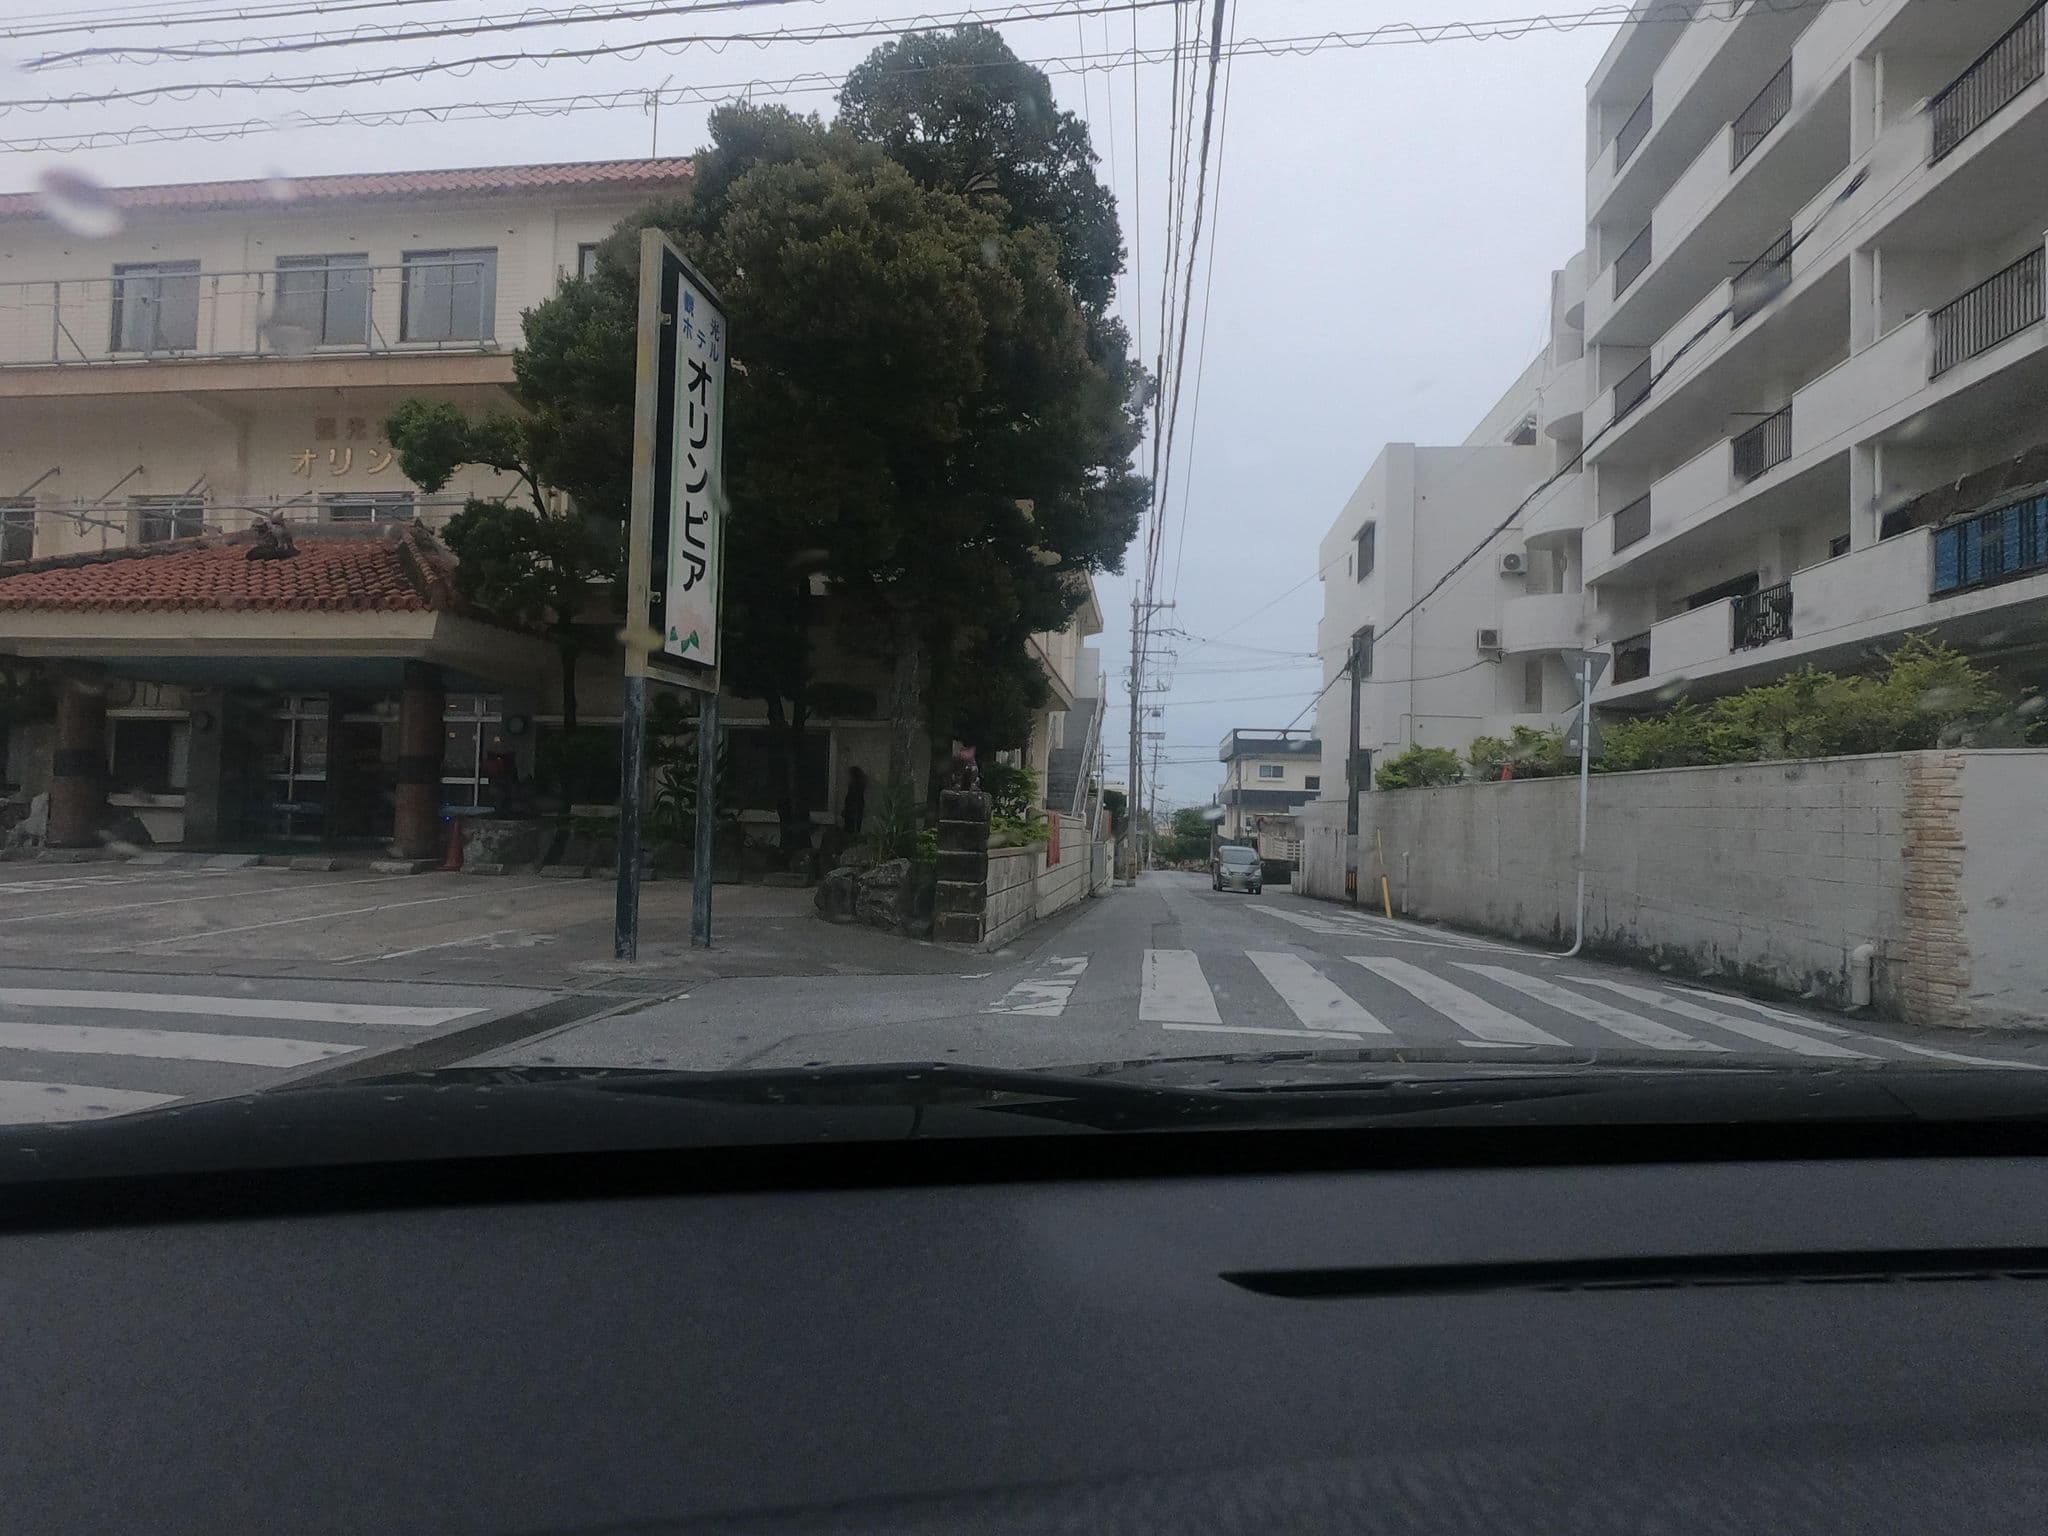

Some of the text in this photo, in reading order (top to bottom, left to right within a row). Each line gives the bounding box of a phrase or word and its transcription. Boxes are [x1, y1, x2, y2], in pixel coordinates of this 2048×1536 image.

[289, 448, 393, 477] オリン
[682, 357, 712, 592] オリンピア
